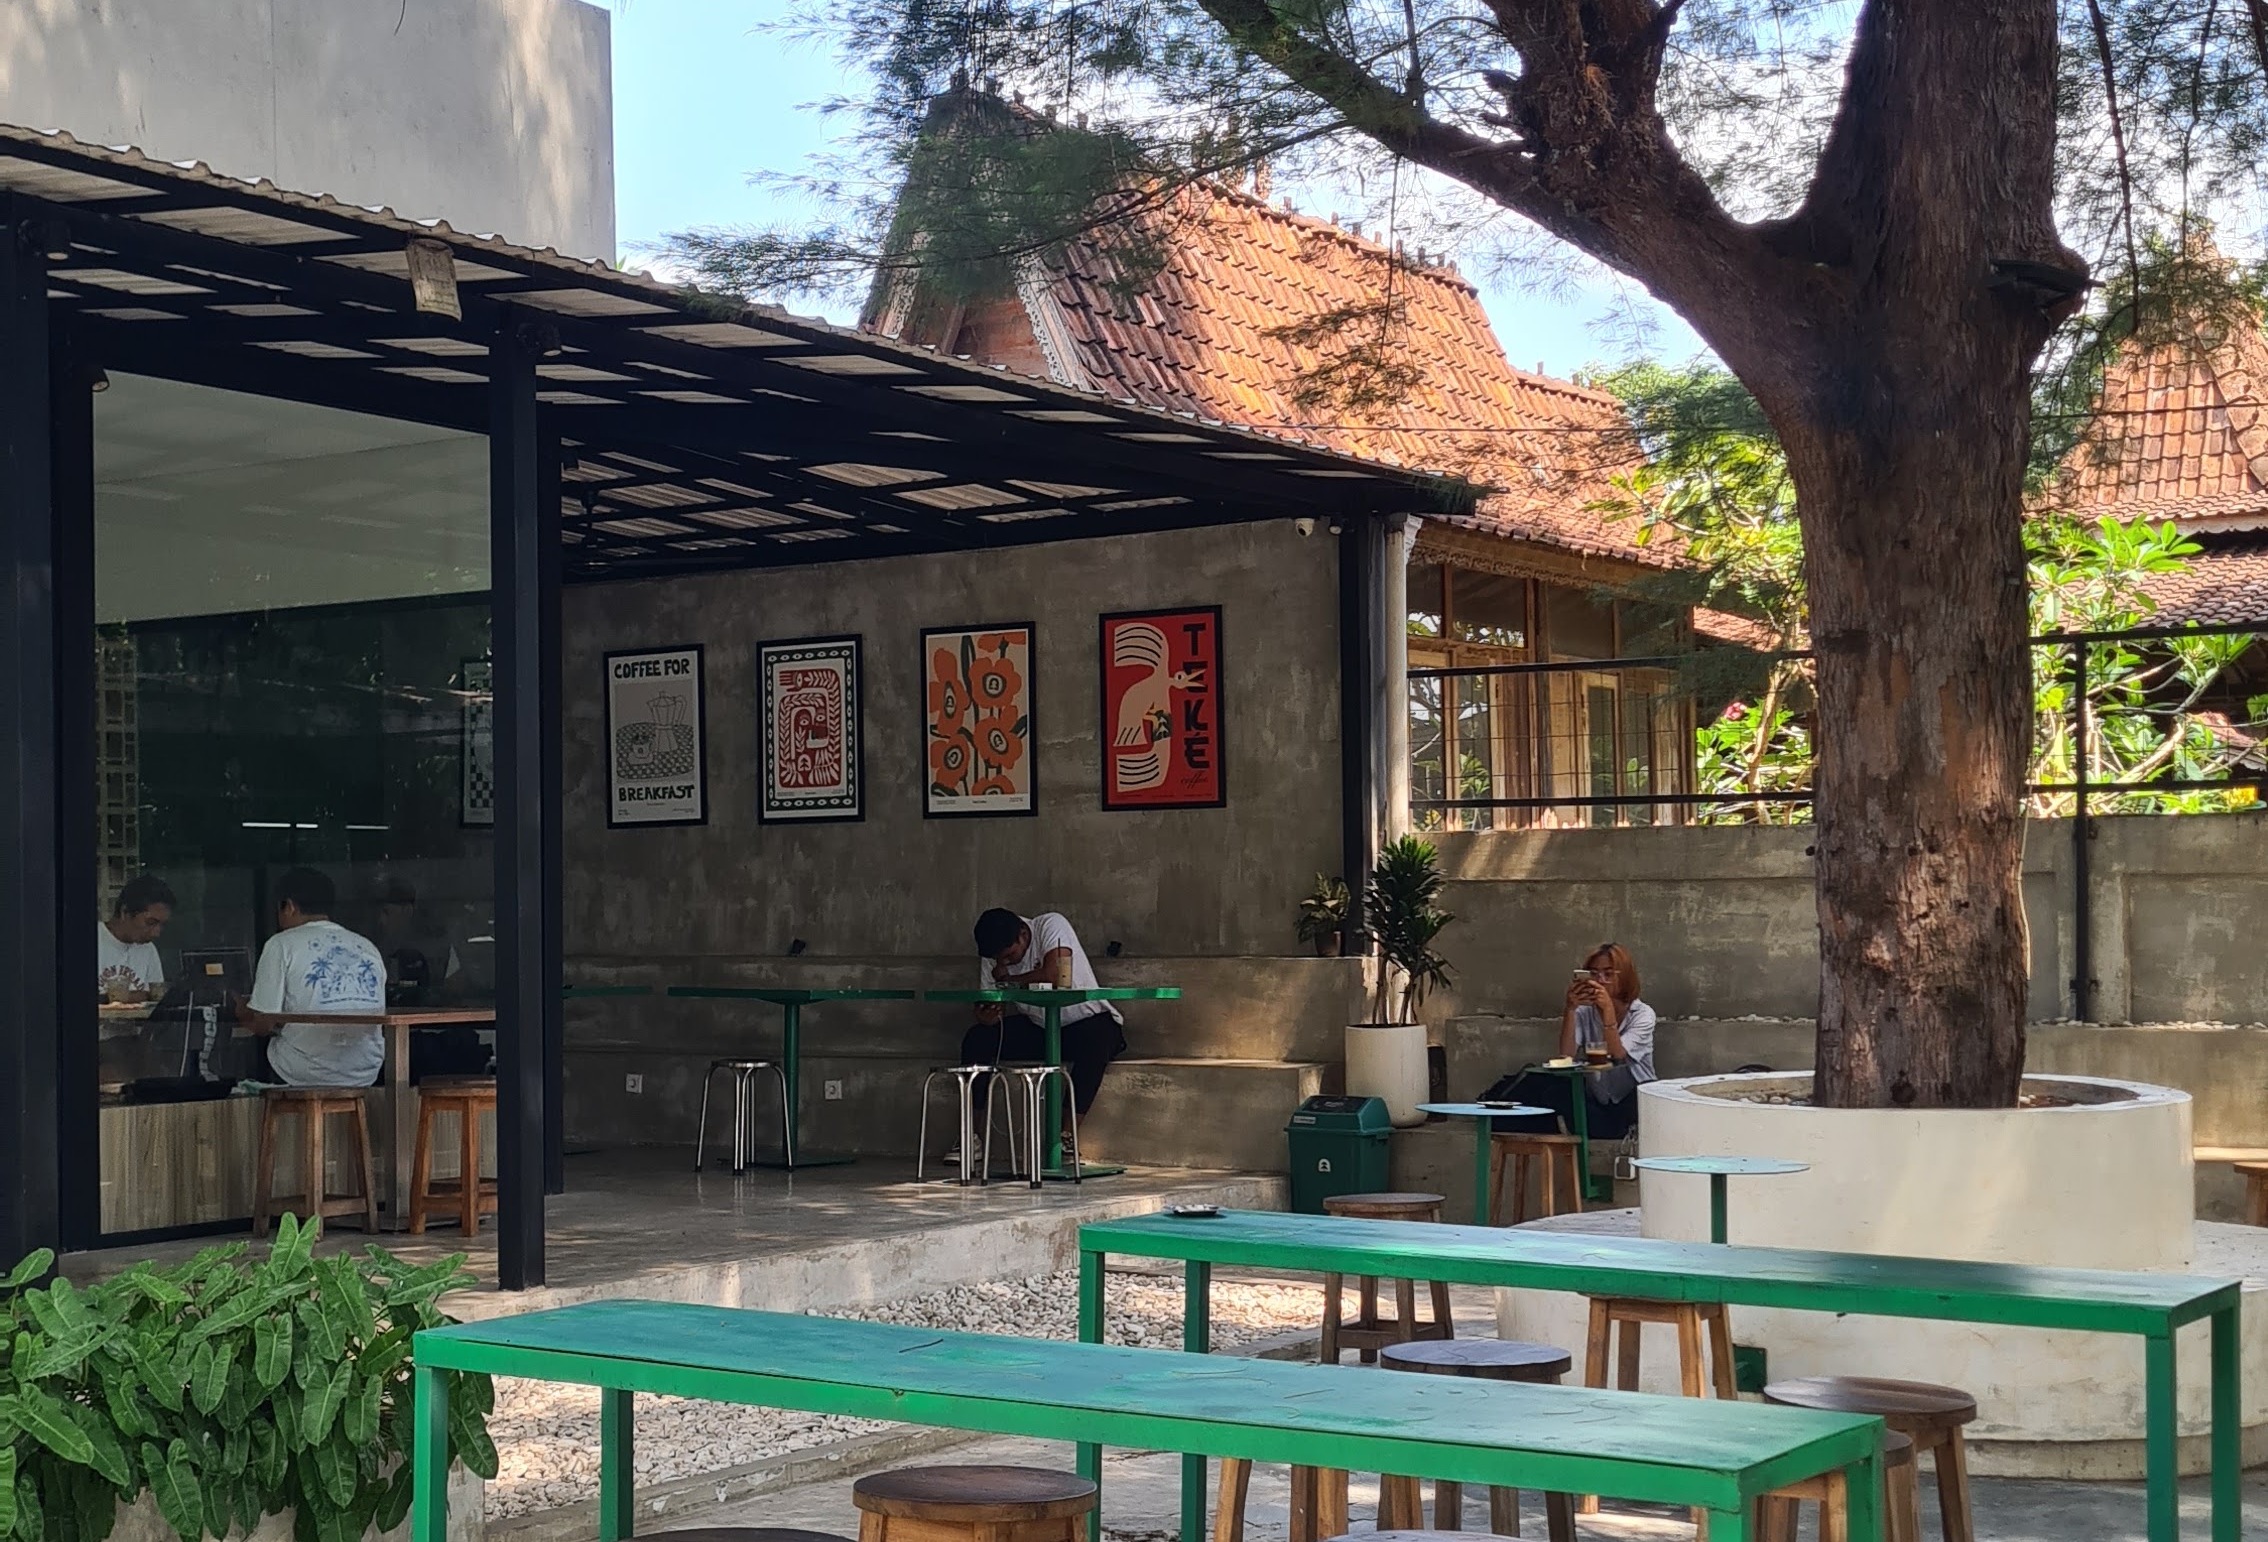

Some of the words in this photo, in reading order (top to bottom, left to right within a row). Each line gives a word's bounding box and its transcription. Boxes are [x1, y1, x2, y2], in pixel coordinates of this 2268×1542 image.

[614, 660, 662, 679] COFFEE
[664, 658, 690, 676] FOR
[618, 784, 695, 802] BREAKFAST
